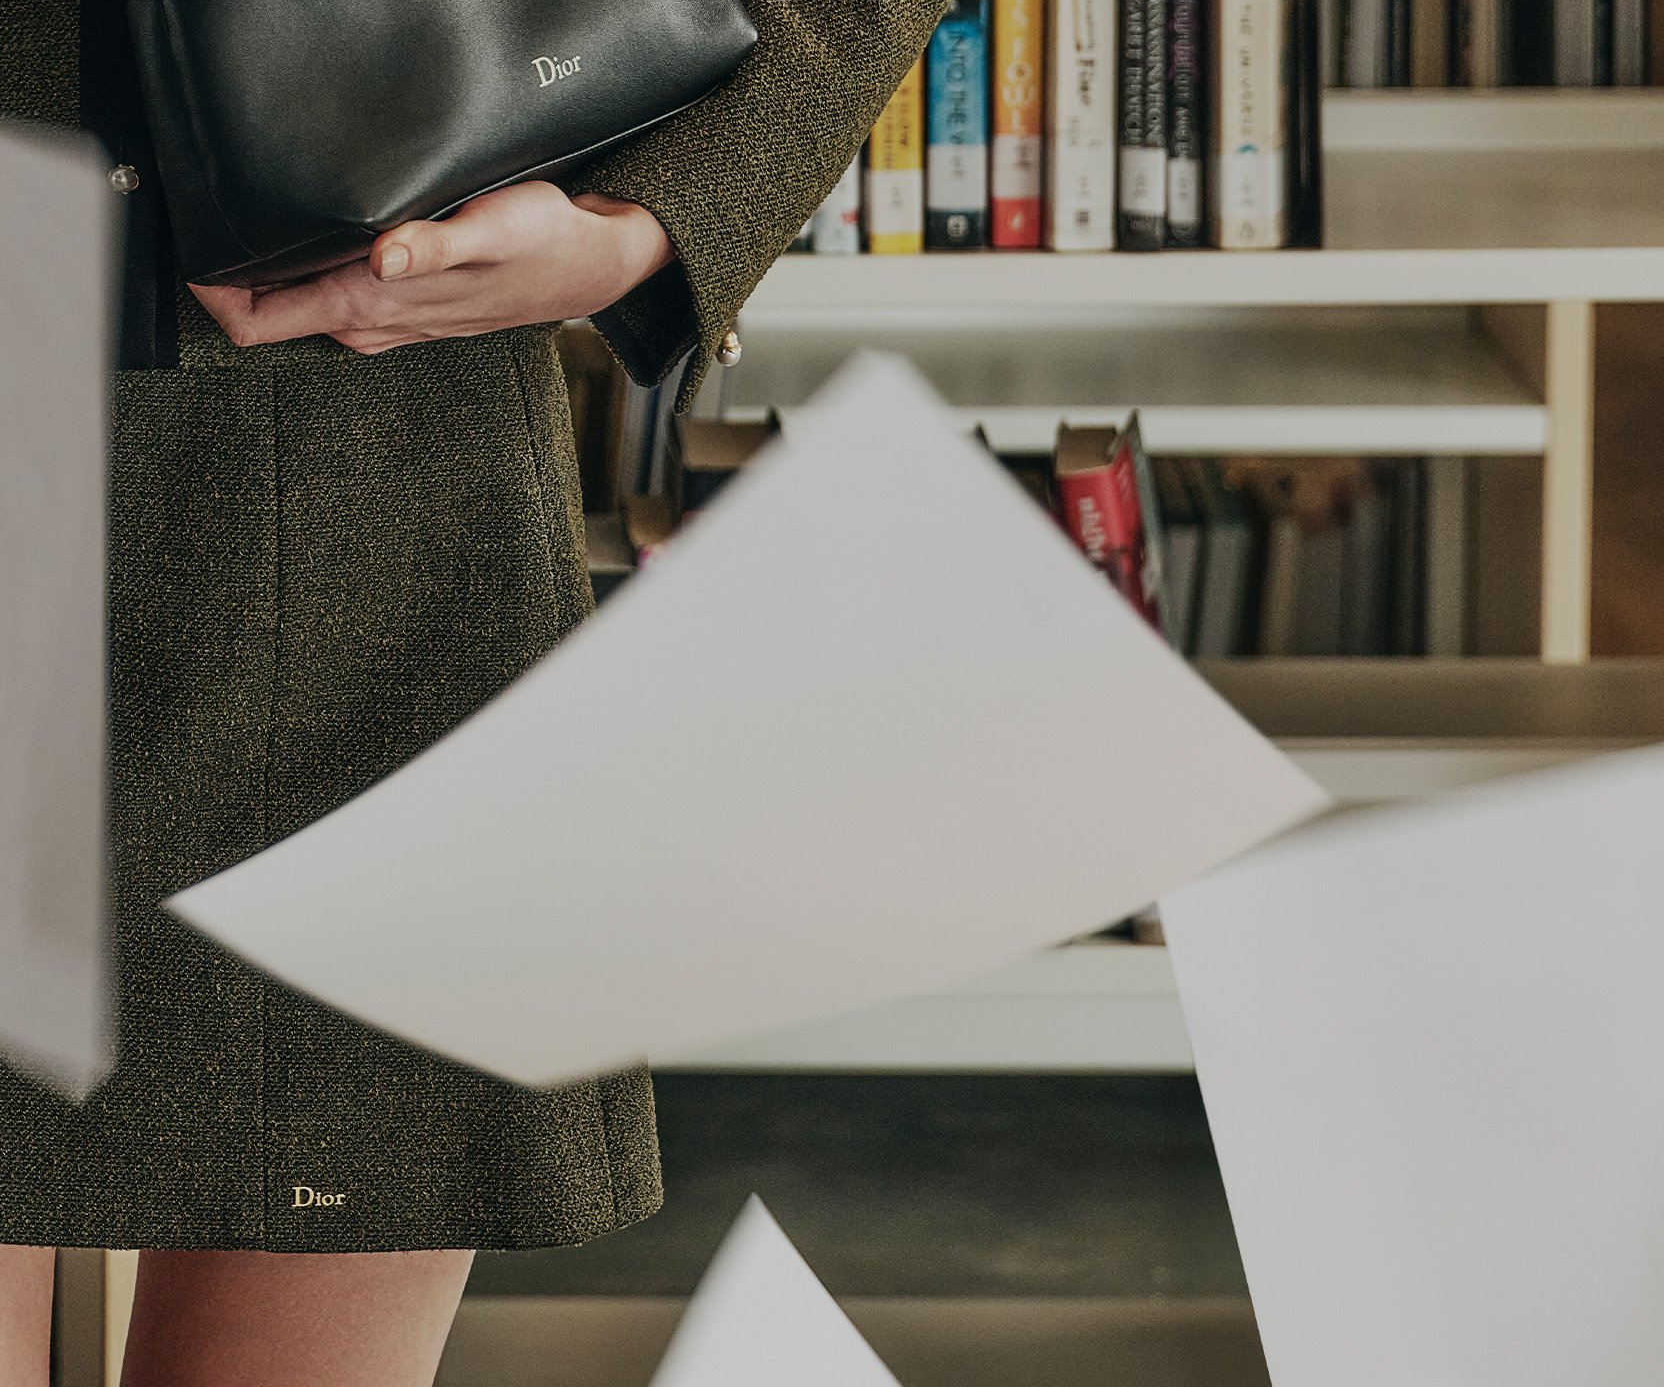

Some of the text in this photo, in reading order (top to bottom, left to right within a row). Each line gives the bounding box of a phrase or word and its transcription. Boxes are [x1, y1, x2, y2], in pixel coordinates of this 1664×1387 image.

[531, 56, 581, 87] Dior
[947, 31, 970, 125] INTO THE
[1124, 65, 1144, 146] THATCH
[291, 1186, 346, 1207] Dior
